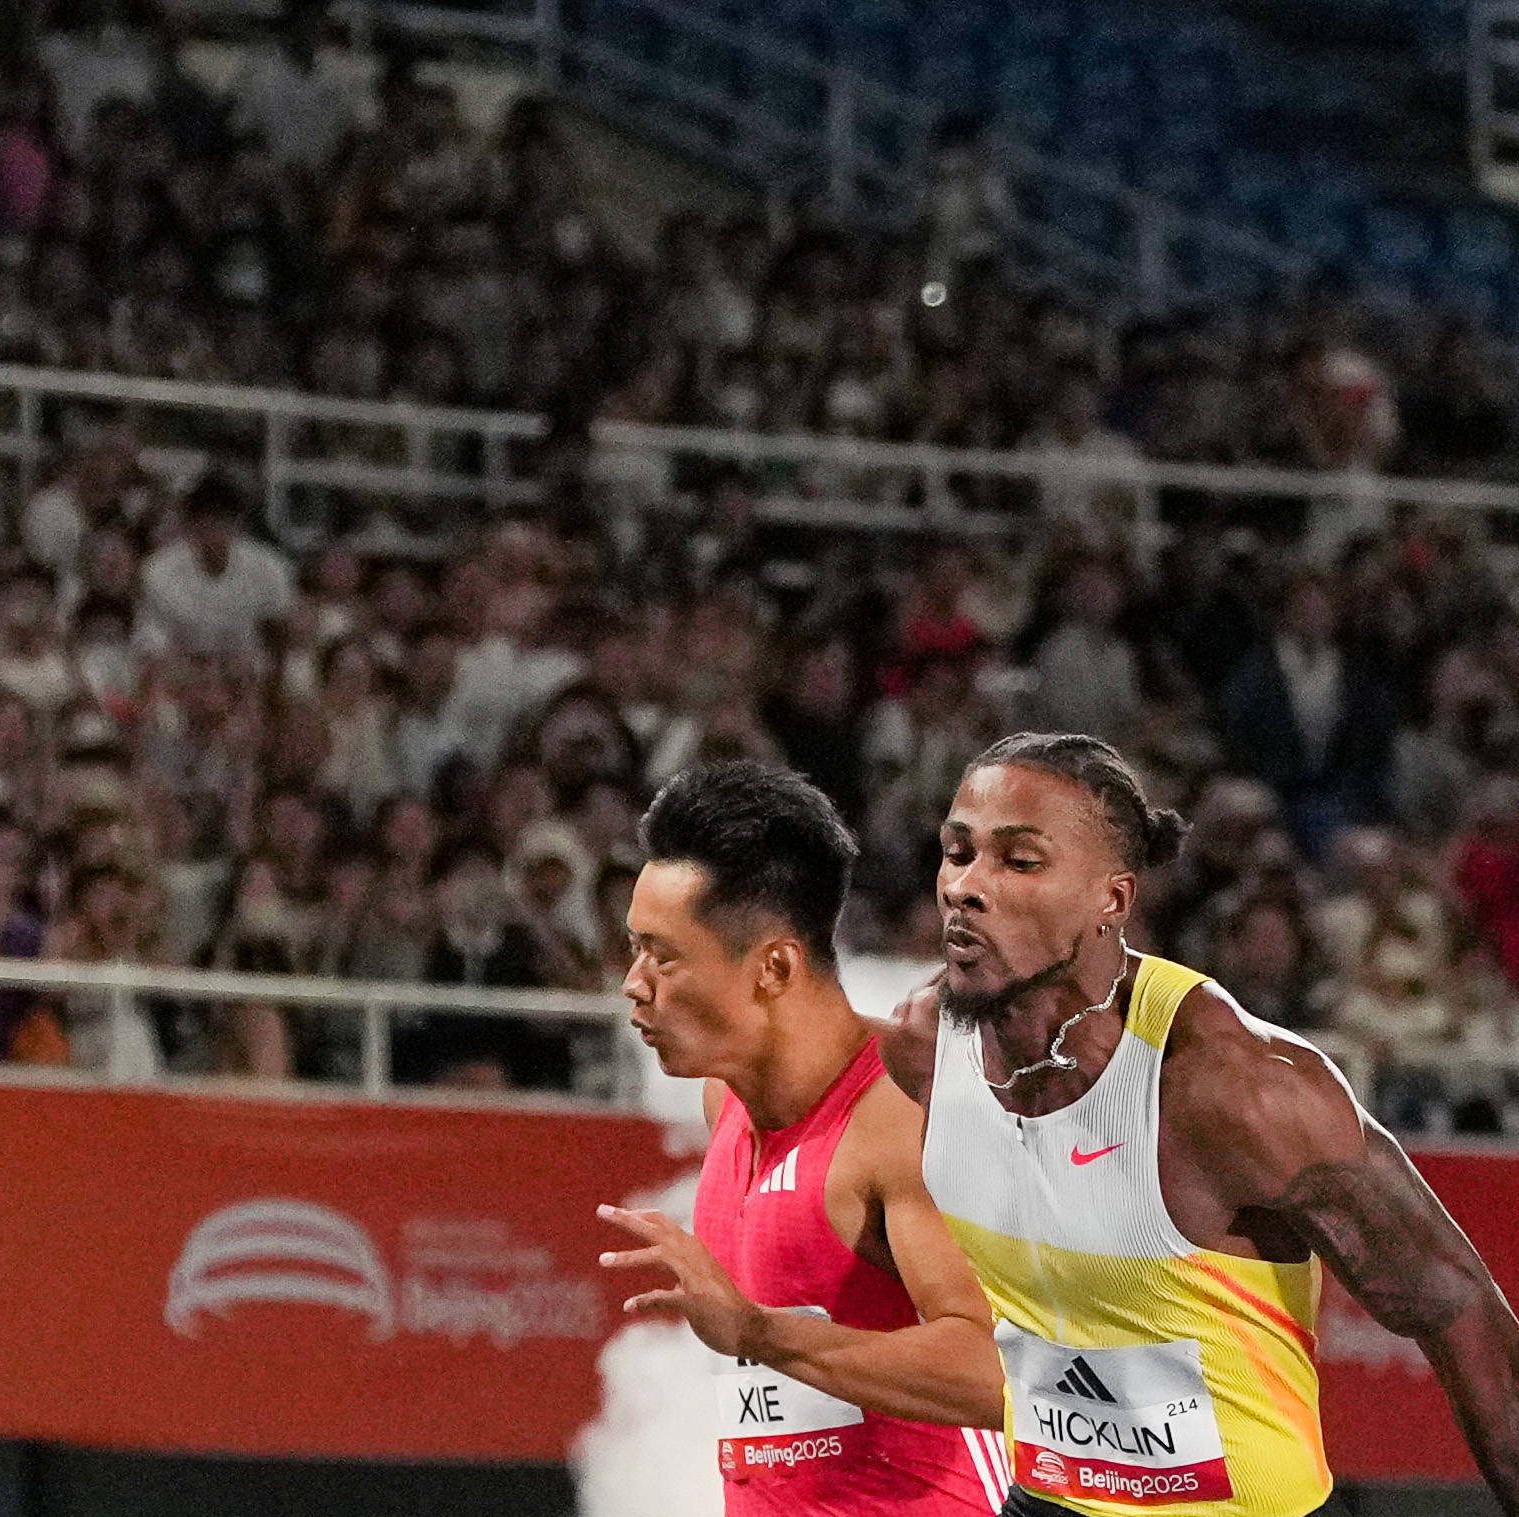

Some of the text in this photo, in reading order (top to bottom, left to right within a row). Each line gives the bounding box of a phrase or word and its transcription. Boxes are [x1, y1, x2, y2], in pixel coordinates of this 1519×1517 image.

[738, 1385, 784, 1424] XIE
[1167, 1398, 1198, 1417] 214
[1033, 1404, 1176, 1456] HICKLIN
[744, 1436, 842, 1468] Beijing2025
[1079, 1467, 1199, 1498] Beijing2025
